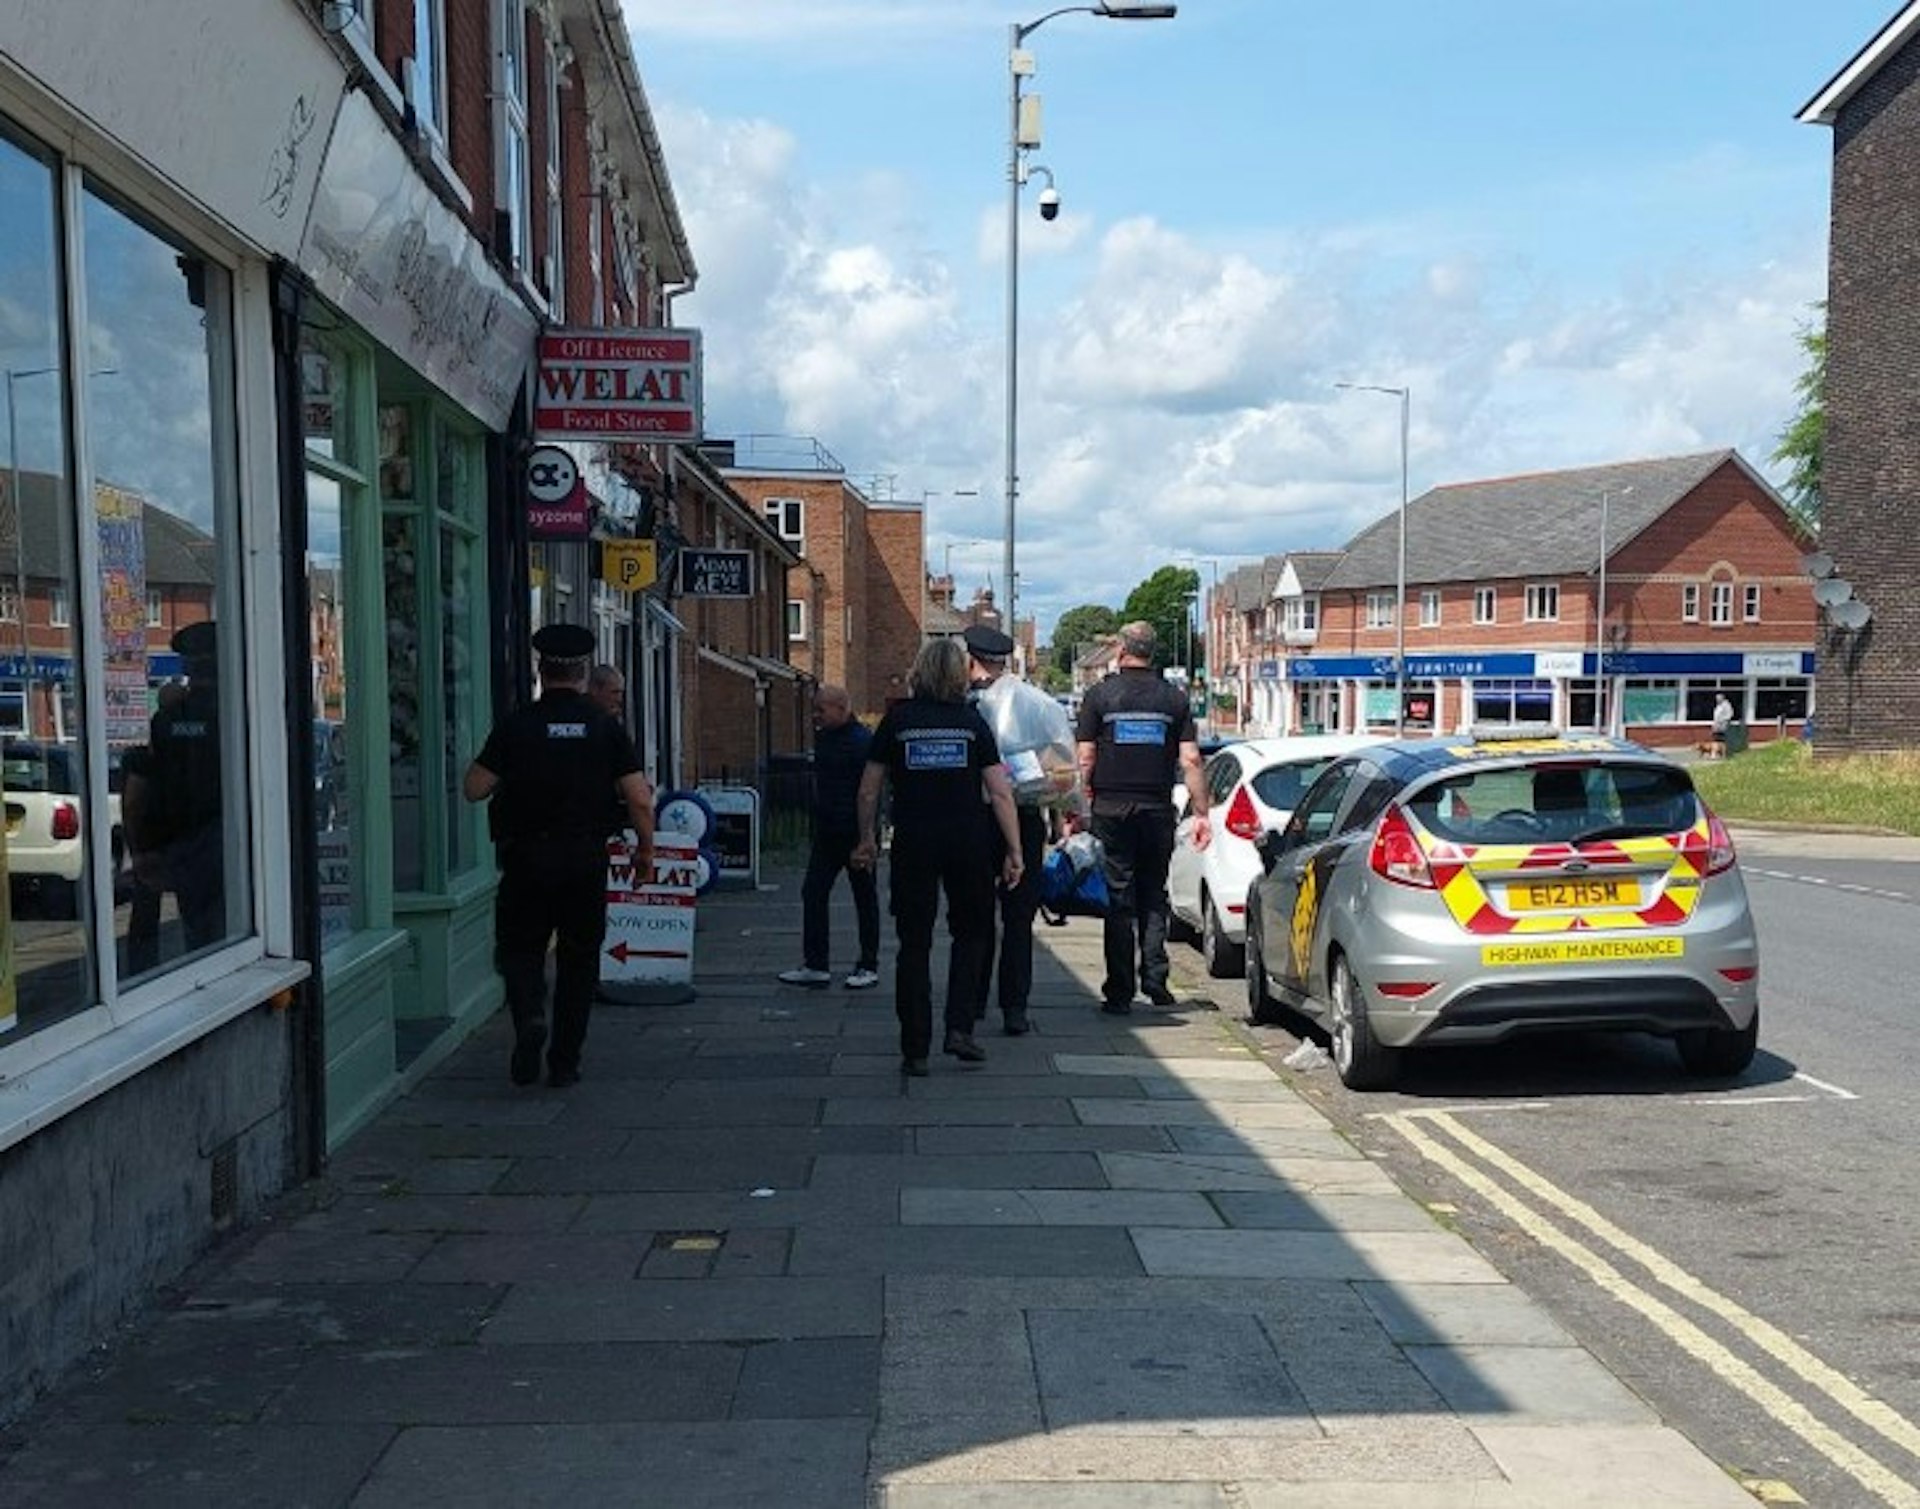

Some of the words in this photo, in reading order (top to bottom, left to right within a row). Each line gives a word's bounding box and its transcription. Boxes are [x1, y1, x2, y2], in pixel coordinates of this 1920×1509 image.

[562, 339, 592, 357] Off
[599, 340, 667, 358] Licence
[541, 368, 690, 401] WELAT
[563, 410, 610, 429] Food
[616, 412, 667, 430] Store
[1408, 662, 1484, 674] FURNITURE
[607, 916, 643, 930] NOW
[648, 917, 689, 931] OPEN
[1490, 945, 1557, 961] HIGHWAY
[1567, 940, 1678, 959] MAINTENANCE
